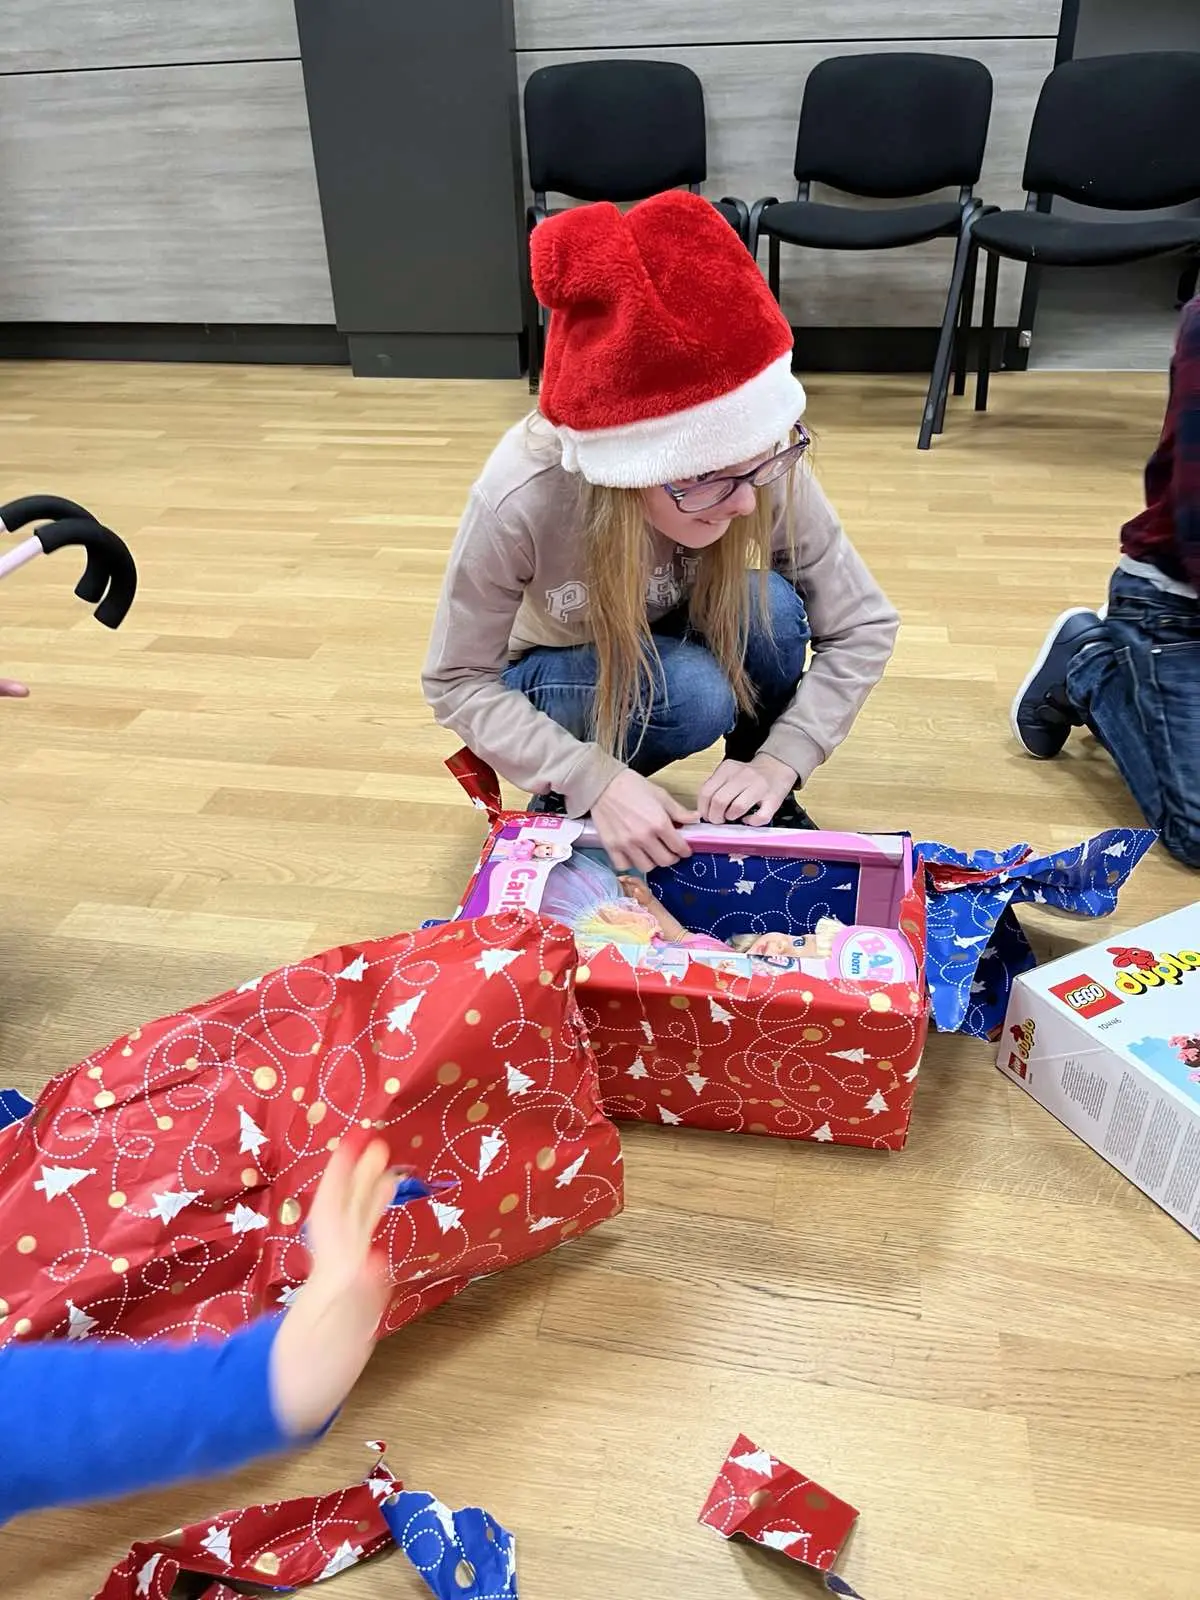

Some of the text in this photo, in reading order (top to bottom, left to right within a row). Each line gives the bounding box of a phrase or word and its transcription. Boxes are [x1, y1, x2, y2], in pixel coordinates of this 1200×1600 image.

[500, 868, 538, 912] Carl
[851, 952, 863, 975] born
[1066, 950, 1200, 1008] LEGO duplo
